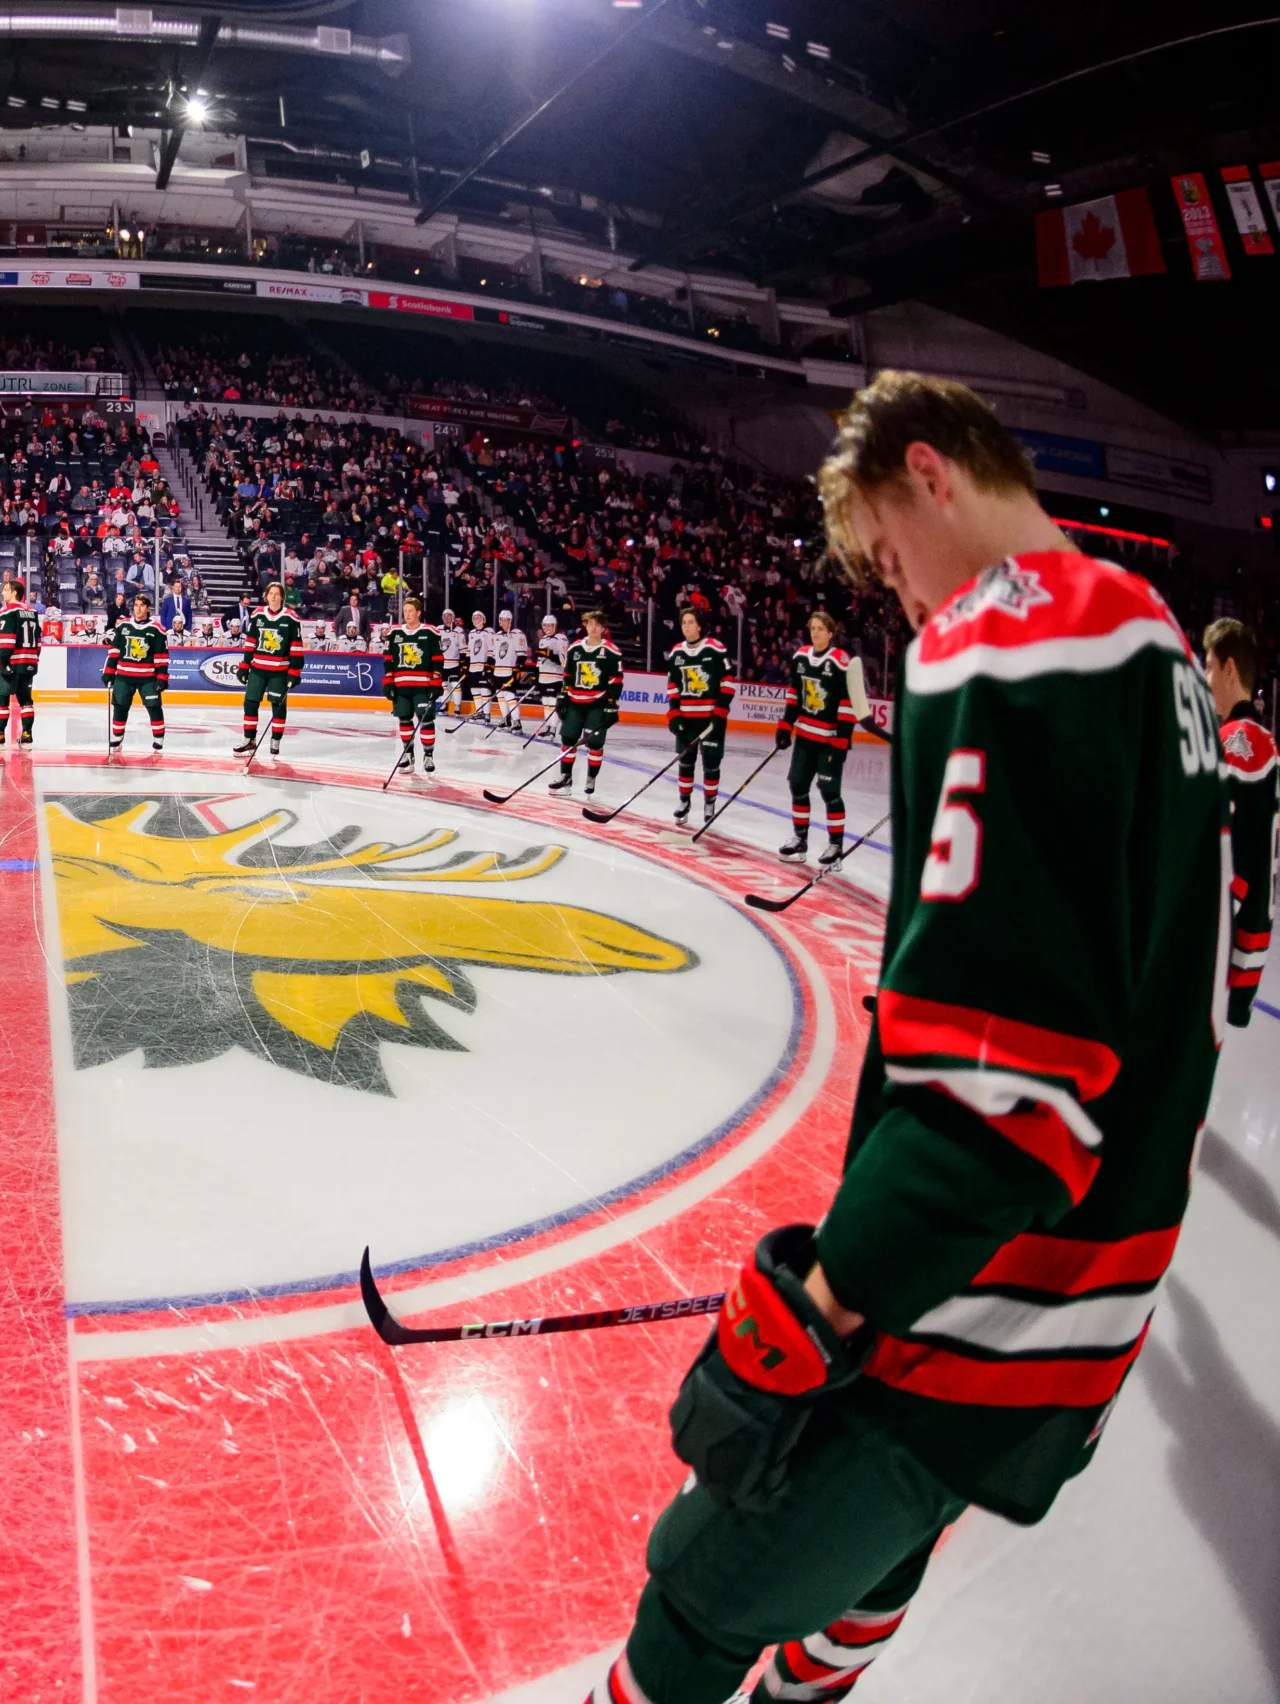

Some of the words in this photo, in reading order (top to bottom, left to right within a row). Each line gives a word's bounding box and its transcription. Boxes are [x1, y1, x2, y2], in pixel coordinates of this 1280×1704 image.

[223, 282, 252, 290] CARSTAR
[269, 285, 308, 297] RE/MAX
[401, 299, 453, 315] Scotiabank
[43, 382, 74, 391] ZONE
[106, 402, 122, 413] 23
[434, 424, 449, 435] 24
[21, 620, 37, 648] 17
[599, 647, 606, 656] A
[742, 703, 769, 713] INJURY
[920, 747, 986, 903] 5
[460, 1317, 542, 1341] CCM
